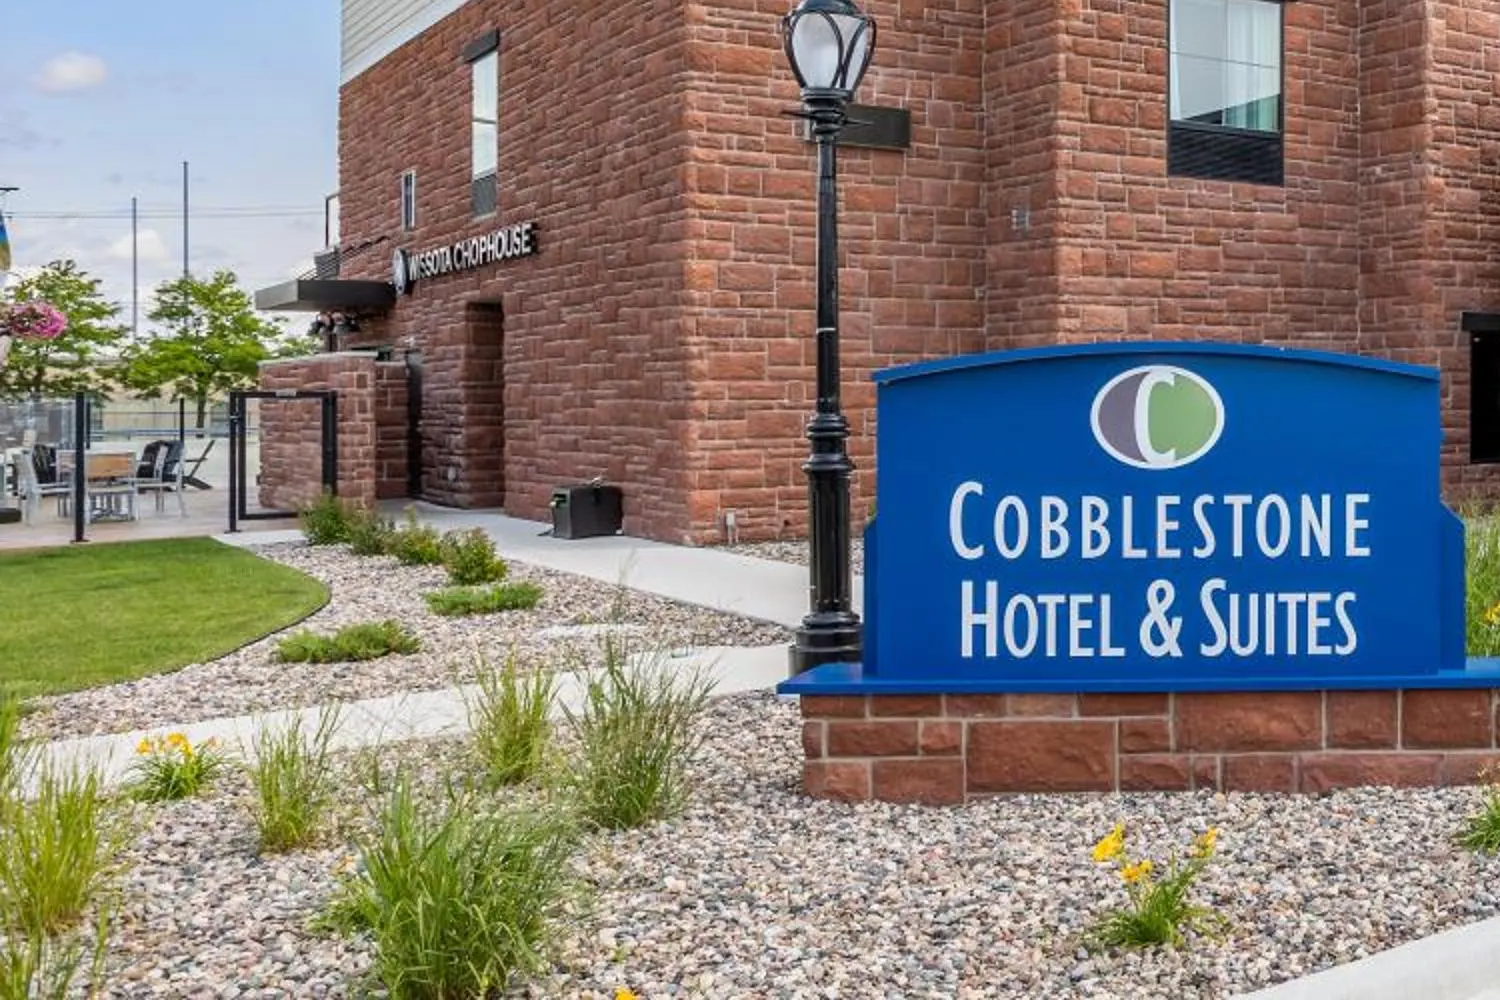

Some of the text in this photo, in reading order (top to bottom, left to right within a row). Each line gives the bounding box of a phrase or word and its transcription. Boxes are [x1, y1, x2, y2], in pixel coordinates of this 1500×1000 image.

[409, 223, 532, 281] WISSOTA CHOPHOUSE
[949, 481, 1371, 560] COBBLESTONE
[961, 577, 1358, 658] HOTEL & SUITES
